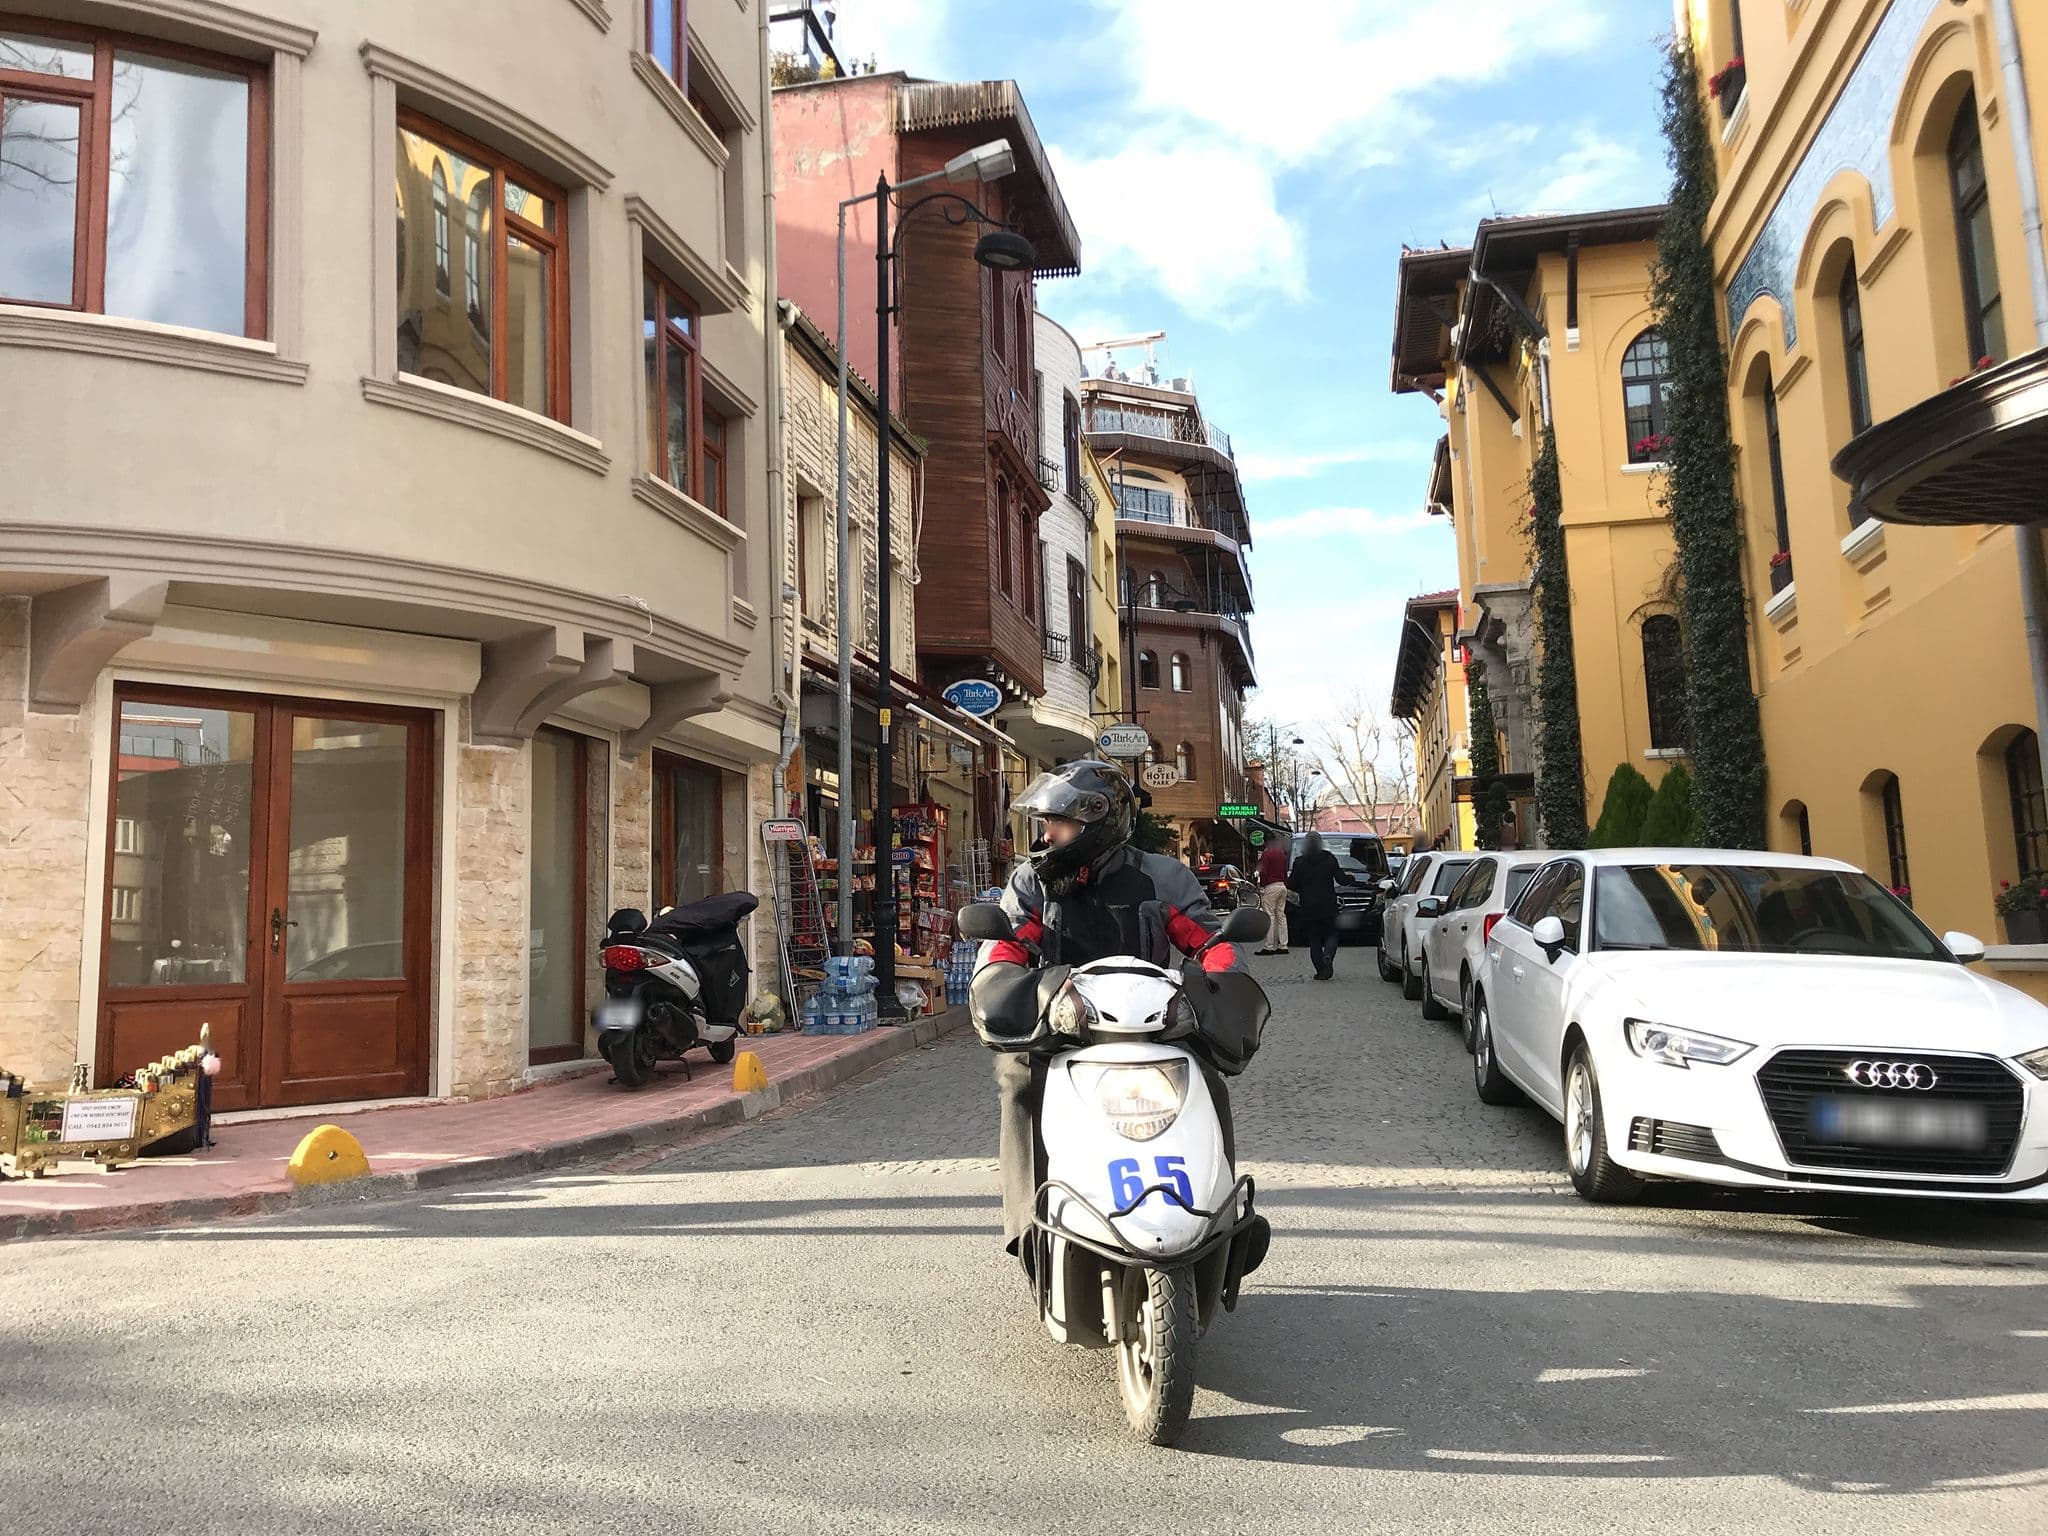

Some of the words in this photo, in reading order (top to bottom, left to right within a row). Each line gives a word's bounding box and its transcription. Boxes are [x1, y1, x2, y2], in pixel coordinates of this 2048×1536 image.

[1146, 772, 1176, 780] HOTEL
[892, 852, 910, 860] RIBO
[1108, 1156, 1194, 1211] 65
